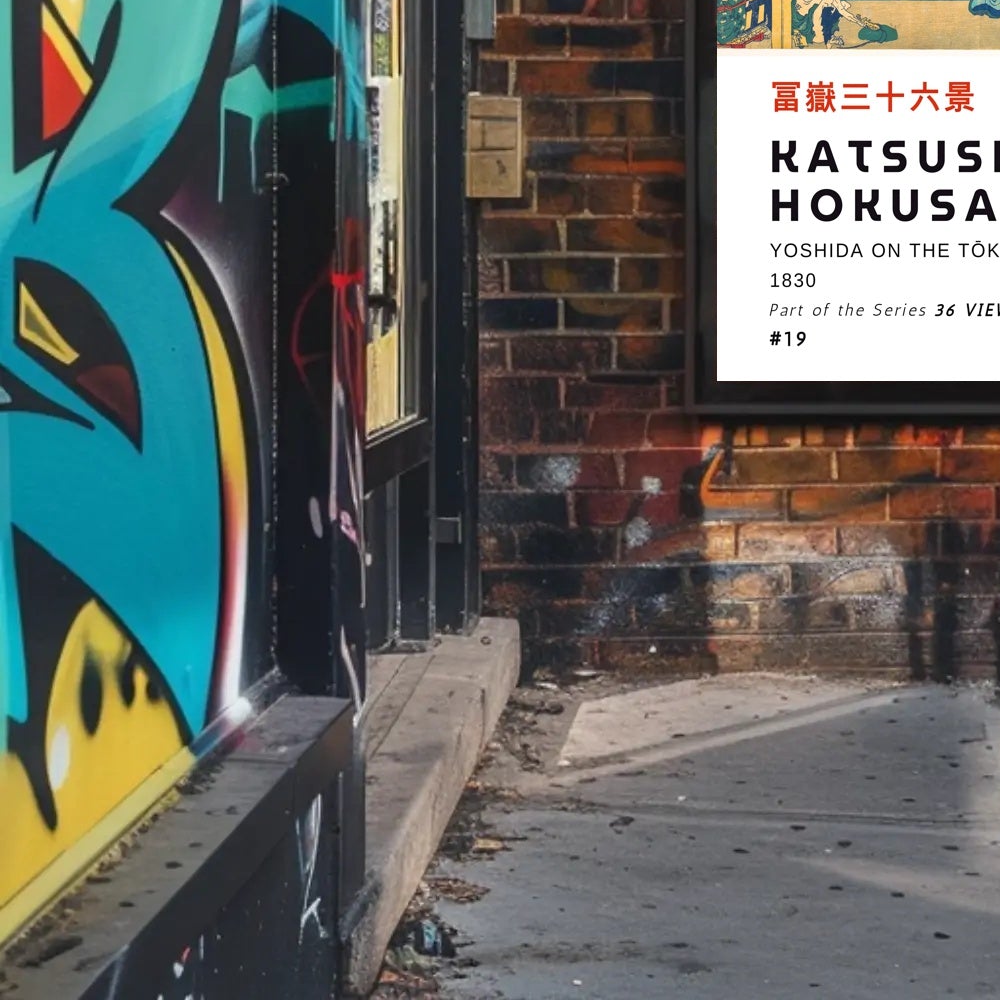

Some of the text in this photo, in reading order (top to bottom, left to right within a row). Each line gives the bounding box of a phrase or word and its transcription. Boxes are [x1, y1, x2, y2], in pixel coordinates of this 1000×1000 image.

[772, 81, 974, 112] 冨嶽三十六景
[770, 243, 863, 258] YOSHIDA
[872, 243, 900, 258] ON
[909, 243, 949, 257] THE
[770, 273, 815, 288] 1830
[770, 303, 803, 316] Part
[812, 303, 830, 316] of
[839, 303, 864, 316] the
[873, 303, 926, 316] Series
[935, 303, 955, 317] 36
[770, 331, 806, 347] #19
